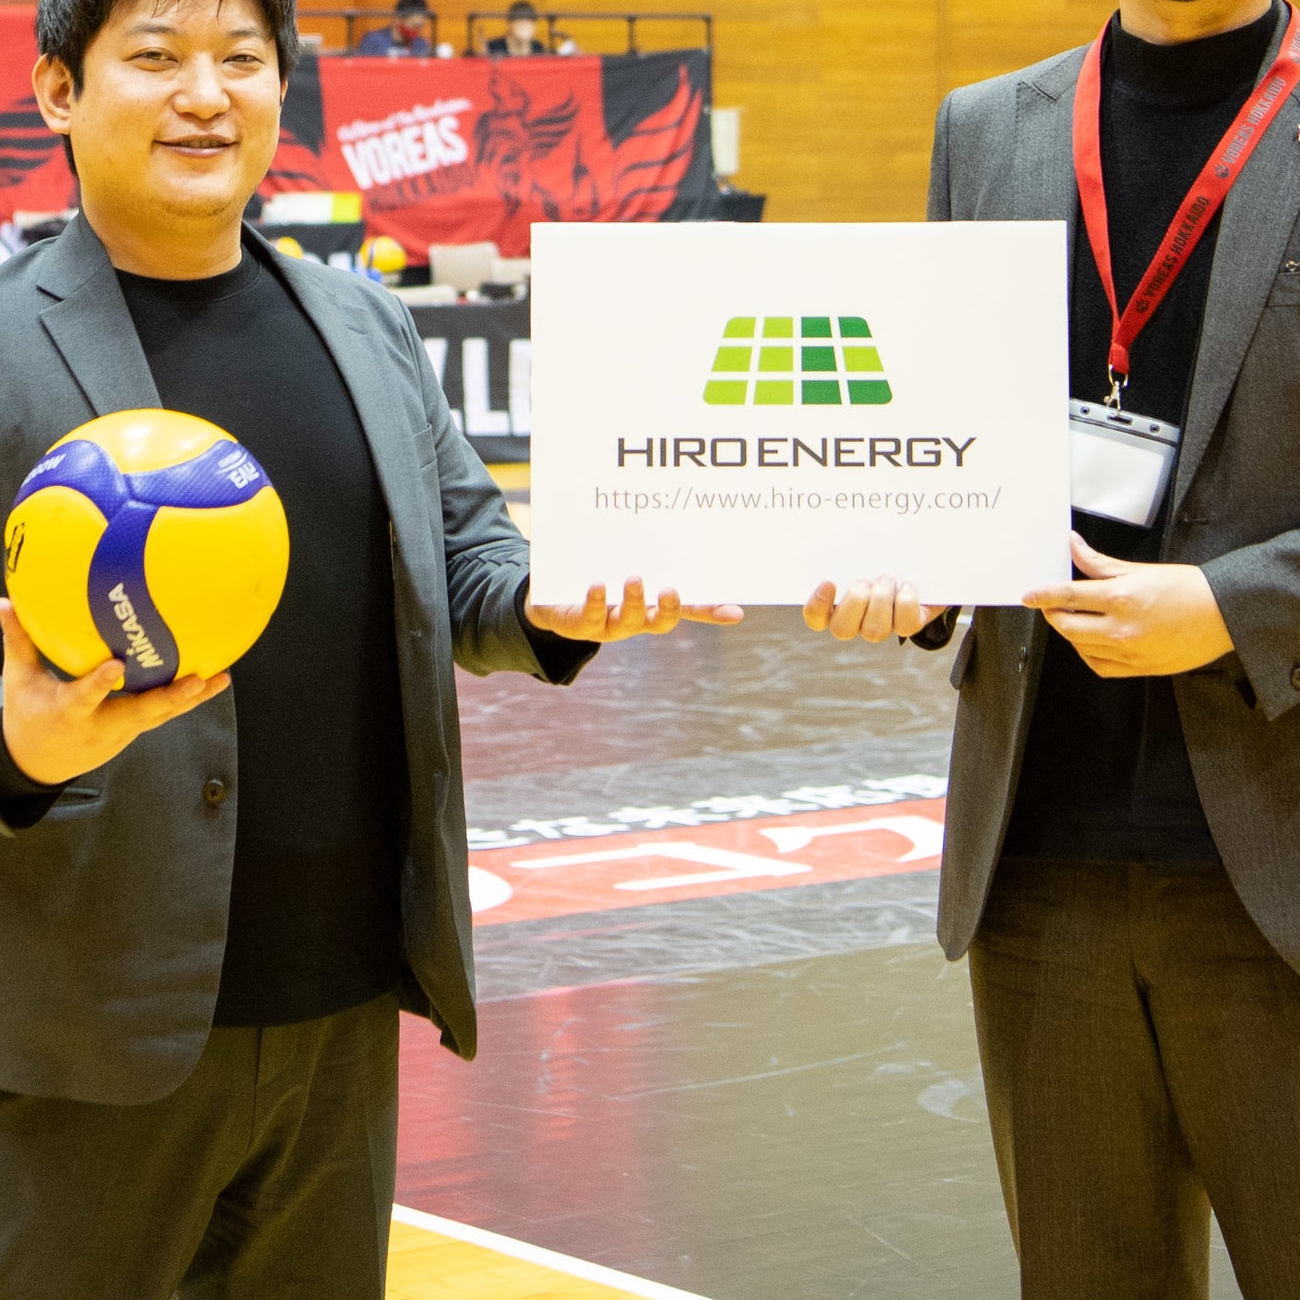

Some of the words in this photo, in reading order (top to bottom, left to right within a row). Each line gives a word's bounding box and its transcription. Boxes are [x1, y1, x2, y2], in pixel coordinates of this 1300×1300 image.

[341, 115, 469, 190] VOREAS
[1222, 123, 1255, 165] VOREAS
[1247, 77, 1287, 126] HOKKAIDO
[1146, 254, 1179, 298] VOREAS
[1171, 195, 1211, 256] HOKKAIDO
[595, 486, 1003, 515] https://www.hiro-energy.com/
[108, 582, 165, 669] MIKASA
